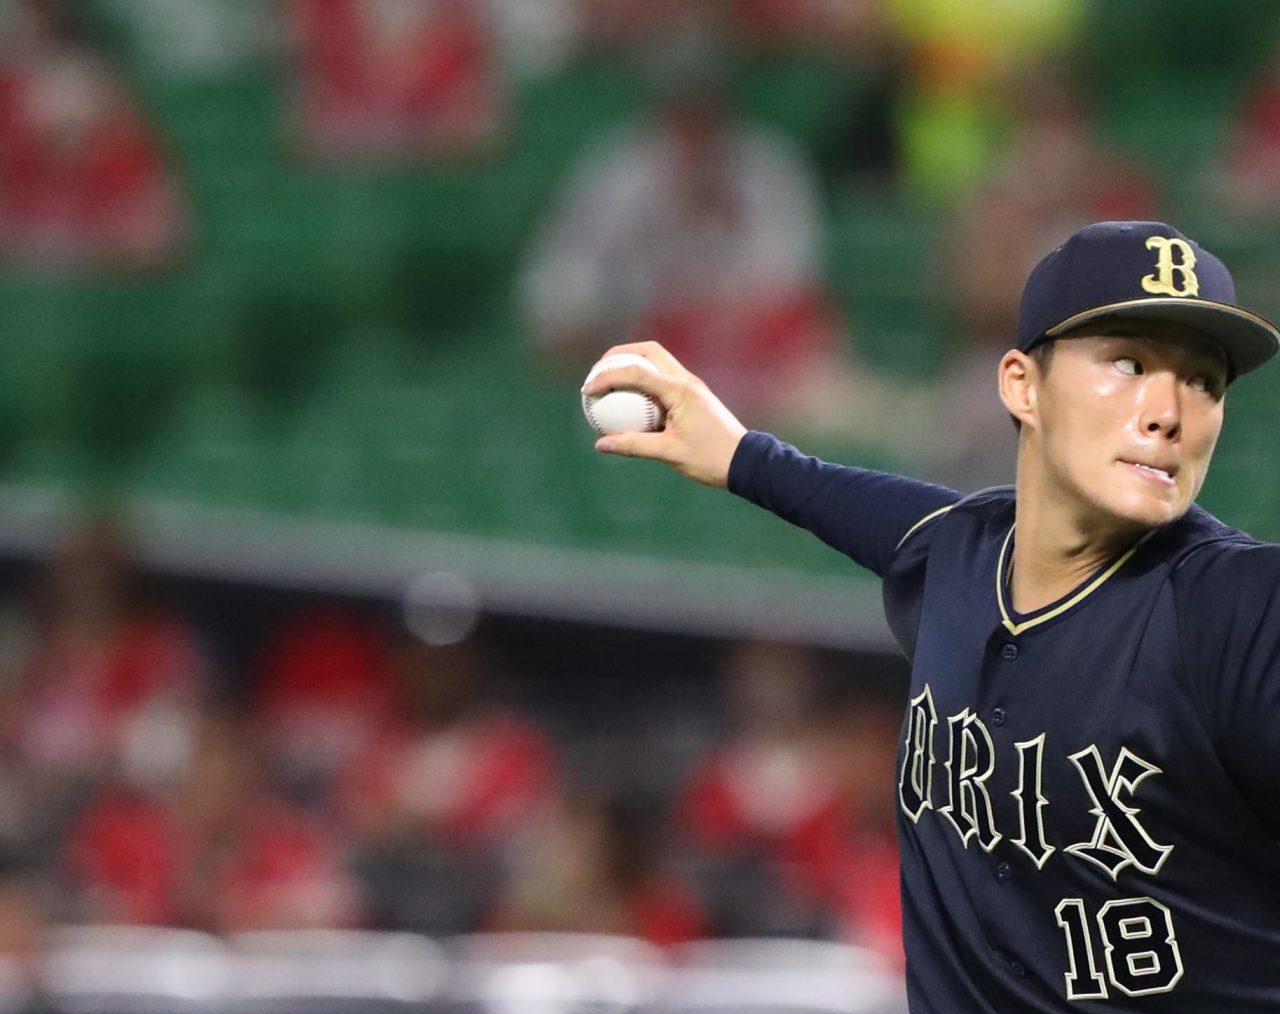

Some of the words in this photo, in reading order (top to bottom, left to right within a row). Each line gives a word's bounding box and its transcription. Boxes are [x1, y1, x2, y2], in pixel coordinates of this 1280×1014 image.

[1141, 236, 1199, 297] B
[899, 683, 1174, 882] ORIX
[1054, 897, 1184, 1001] 18
